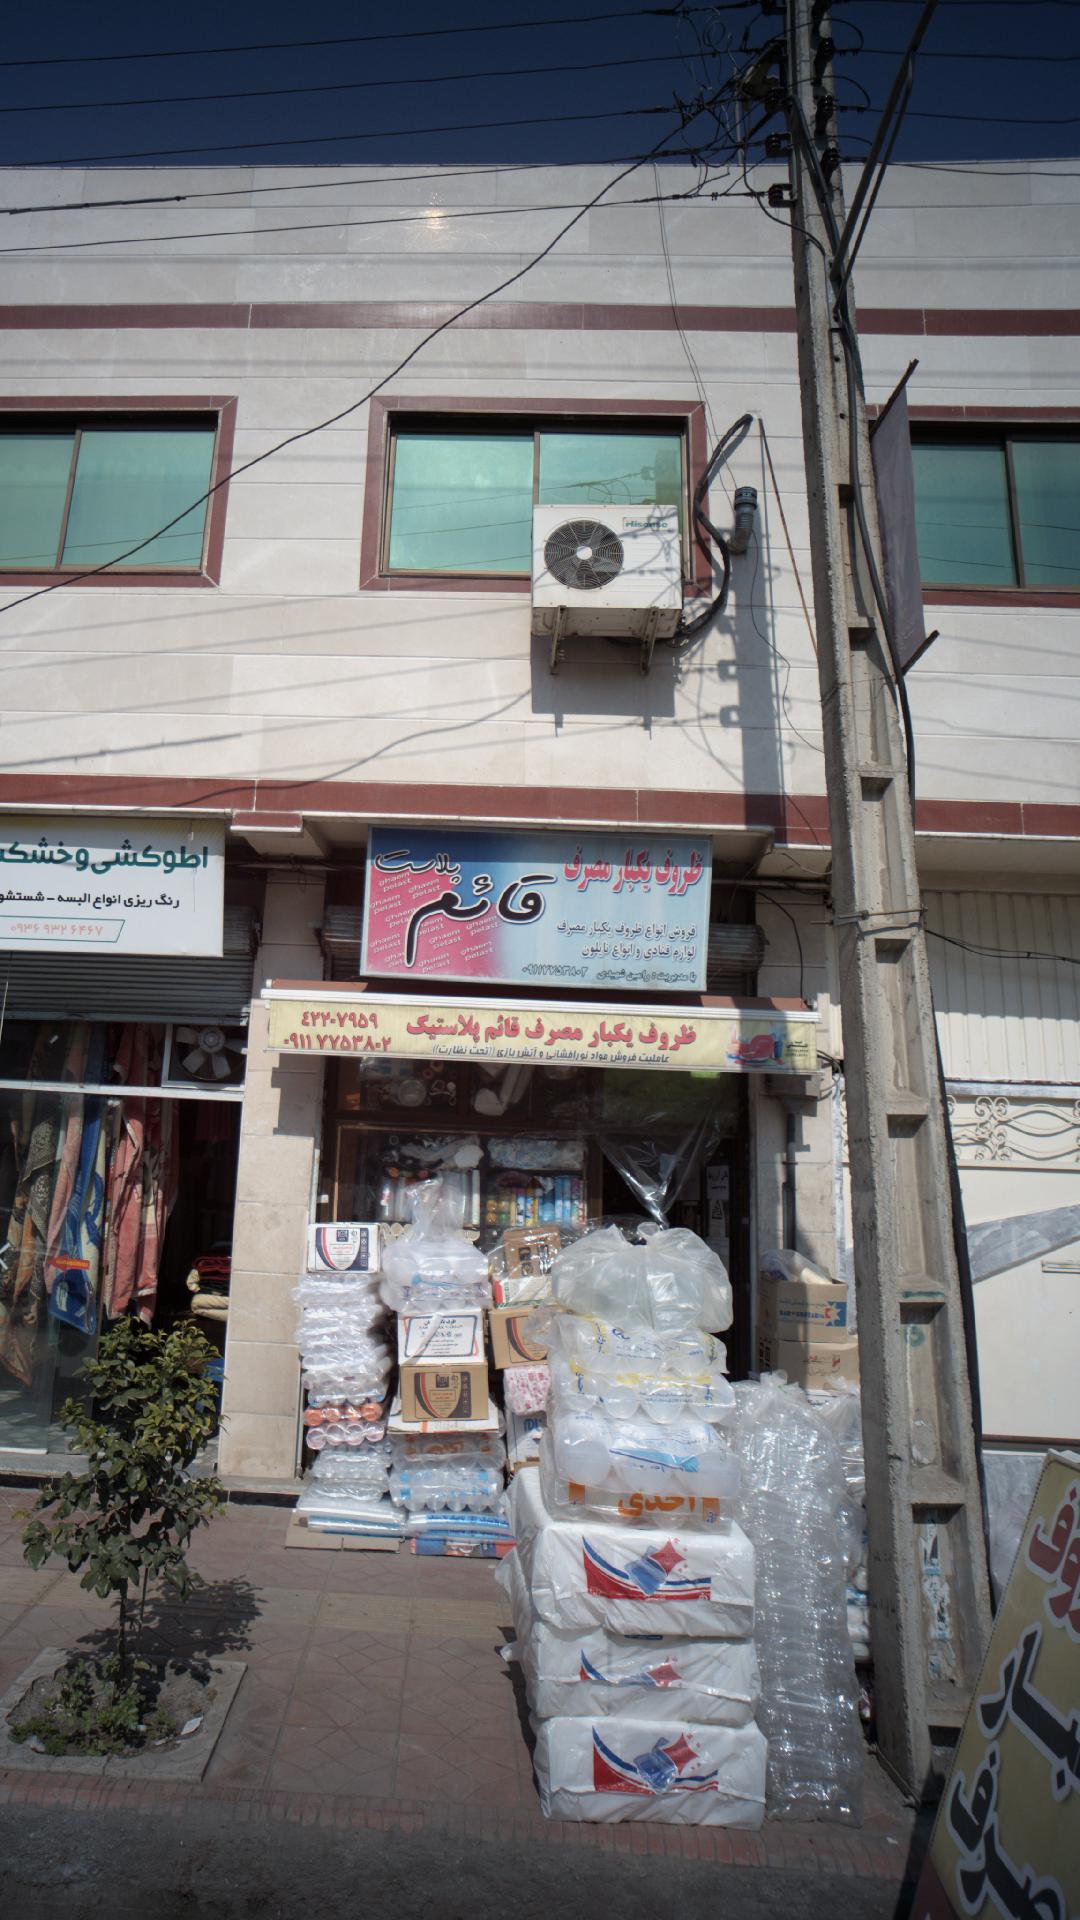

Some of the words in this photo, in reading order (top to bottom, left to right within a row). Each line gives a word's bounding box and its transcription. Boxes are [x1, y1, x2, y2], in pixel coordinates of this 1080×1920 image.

[91, 839, 208, 874] اطوکشی
[563, 844, 611, 892] مصرف
[612, 848, 652, 893] یکبار
[653, 849, 704, 896] ظروف
[57, 893, 90, 907] البسه
[93, 894, 121, 909] انواع
[124, 893, 152, 908] ریزی
[155, 893, 181, 908] رنگ
[556, 919, 586, 937] مصرف
[588, 921, 612, 937] یکبار
[615, 922, 642, 938] ظروف
[644, 923, 667, 940] انواع
[668, 924, 697, 941] فروش
[580, 941, 609, 958] نایلون
[611, 942, 634, 959] انواع
[643, 943, 671, 960] قنادی
[672, 943, 696, 962] لوازم
[406, 1014, 480, 1043] پلاستیک
[484, 1014, 520, 1043] قائم
[525, 1016, 584, 1046] مصرف
[588, 1020, 634, 1048] یکبار
[638, 1022, 698, 1051] ظروف
[496, 1045, 516, 1058] بازی
[517, 1046, 537, 1058] آتش
[545, 1048, 588, 1061] نورافشانی
[590, 1050, 608, 1060] مواد
[610, 1050, 637, 1063] فروش
[638, 1052, 670, 1064] عاملیت
